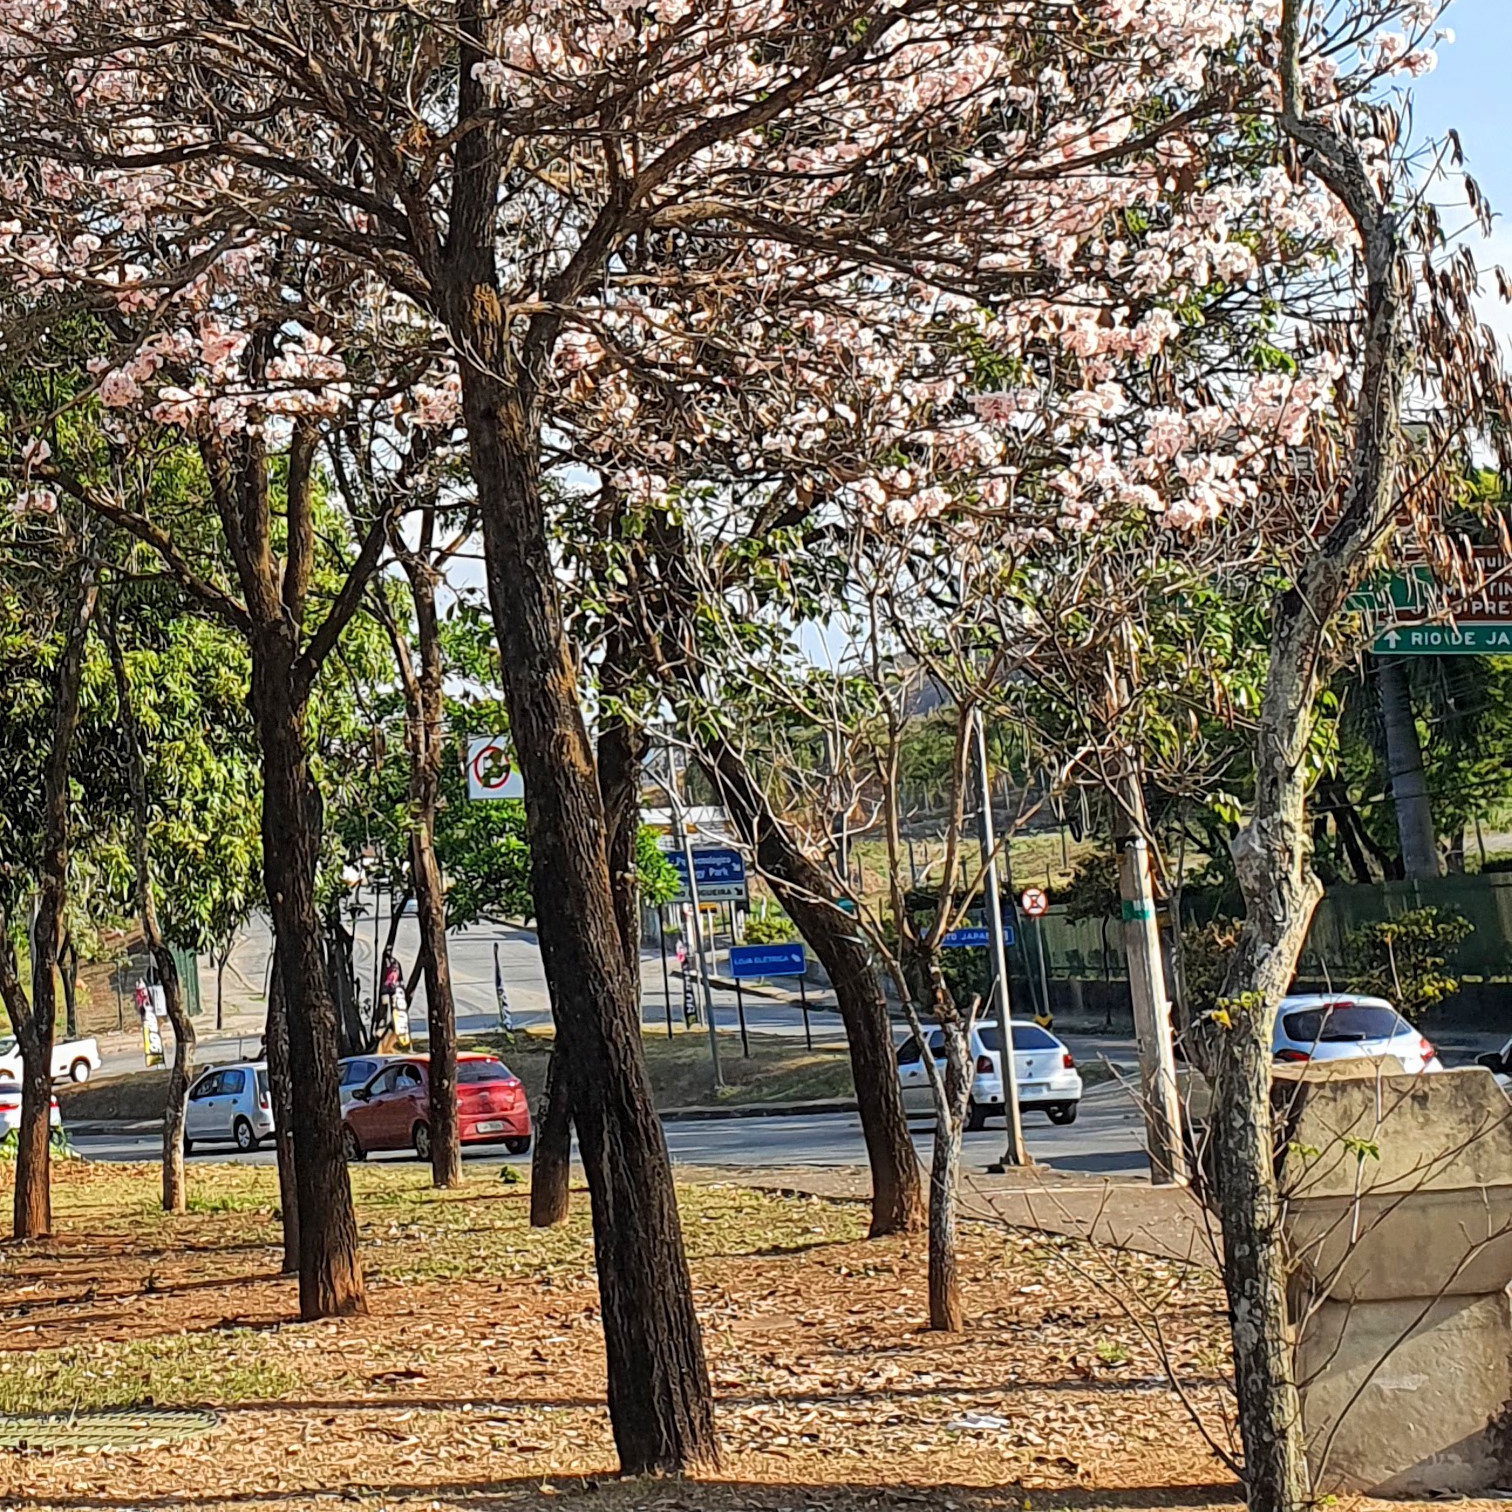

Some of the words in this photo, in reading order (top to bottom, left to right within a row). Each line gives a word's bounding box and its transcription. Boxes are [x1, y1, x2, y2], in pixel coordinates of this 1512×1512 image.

[1472, 601, 1512, 614] PRE
[1411, 631, 1442, 646] RIO
[1451, 631, 1476, 646] DE
[1486, 631, 1512, 646] JA
